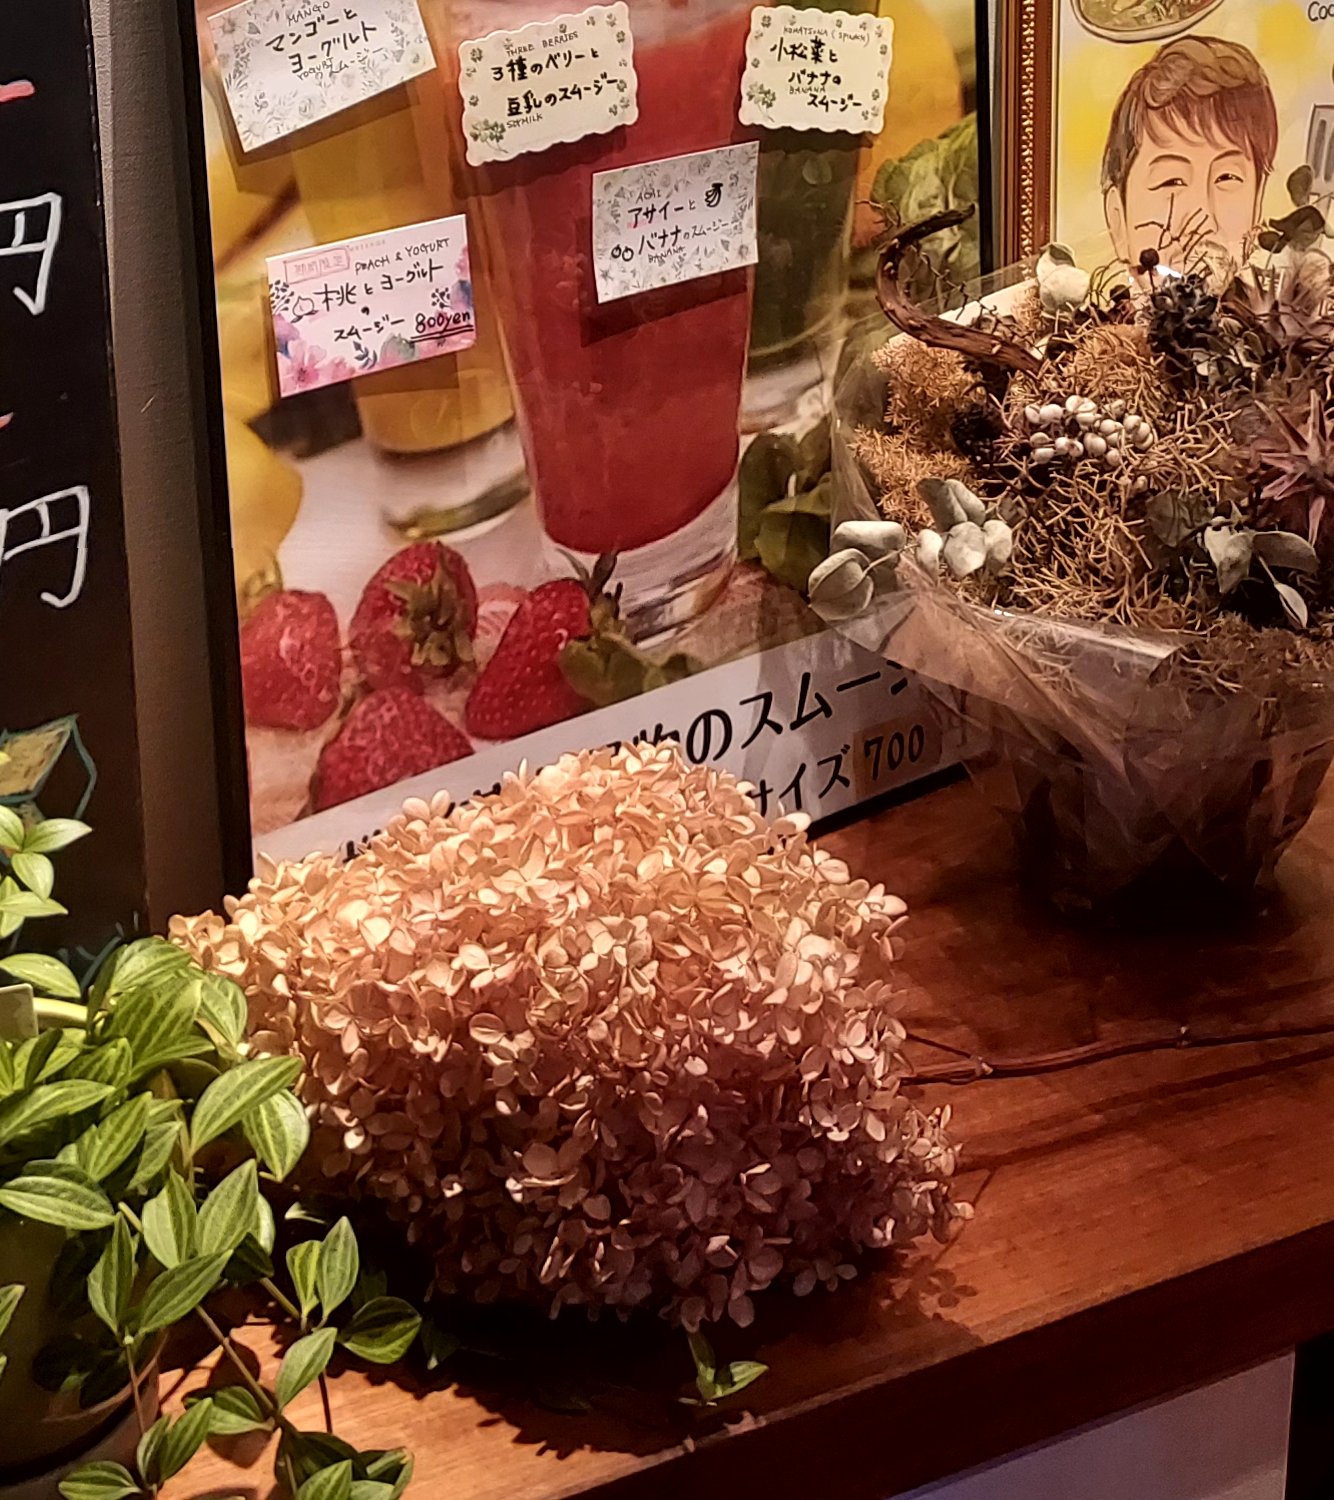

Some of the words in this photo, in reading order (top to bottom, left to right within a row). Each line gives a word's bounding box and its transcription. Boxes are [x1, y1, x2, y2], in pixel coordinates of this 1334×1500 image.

[265, 7, 358, 52] マンゴーと
[287, 0, 331, 27] MANGO
[288, 20, 378, 74] ヨーグルト
[404, 237, 450, 257] YOGURT
[415, 310, 472, 335] 800yen
[862, 723, 926, 782] 700
